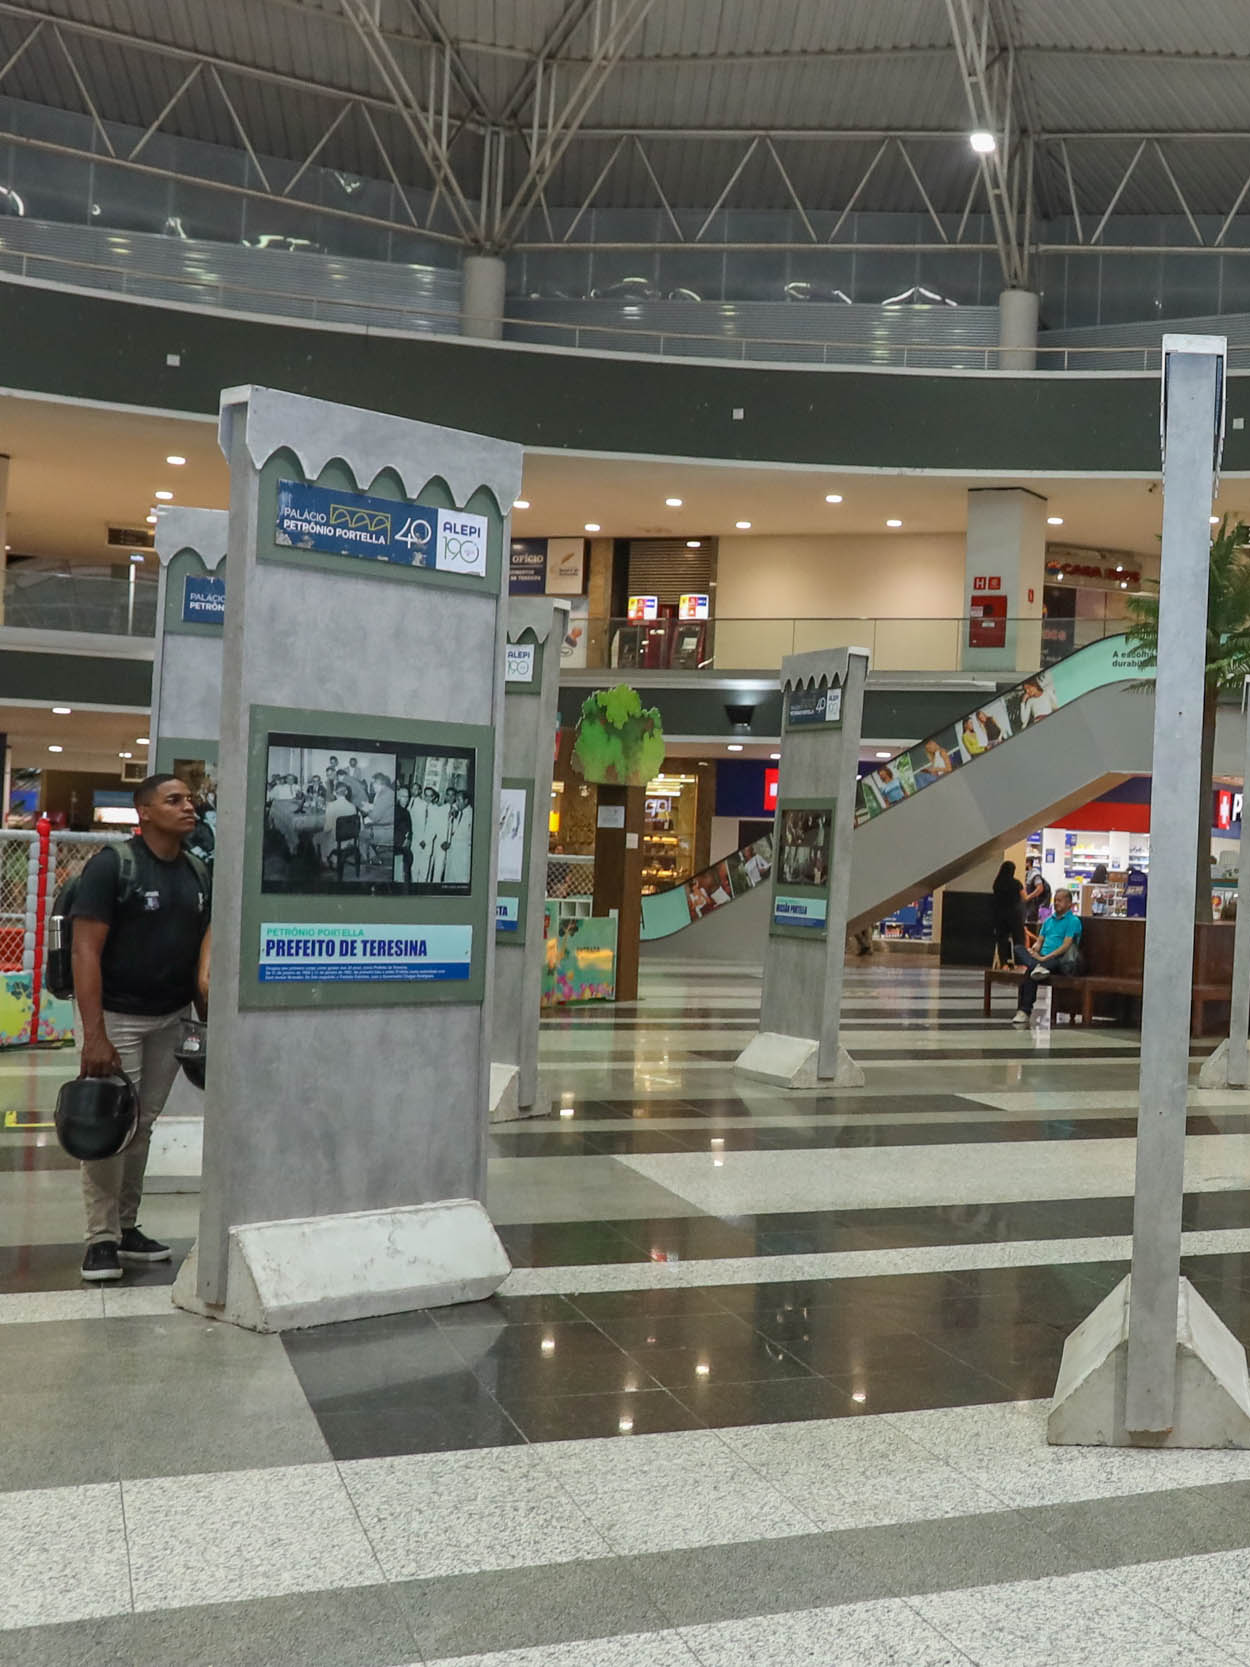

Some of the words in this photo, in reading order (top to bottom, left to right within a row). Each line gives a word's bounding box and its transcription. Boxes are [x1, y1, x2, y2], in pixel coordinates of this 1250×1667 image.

[284, 507, 327, 523] PALÁCIO
[283, 519, 334, 535] PETRÔNIO
[336, 528, 386, 545] PORTELLA
[394, 518, 432, 549] 40
[443, 521, 481, 539] ALEPI
[443, 536, 479, 564] 190
[189, 601, 224, 611] PETRÔN
[507, 650, 531, 659] ALEPI
[267, 927, 315, 937] PETRÔNIO
[317, 928, 364, 937] PORTELLA
[265, 939, 336, 957] PREFEITO
[339, 939, 357, 957] DE
[360, 939, 428, 957] TERESINA
